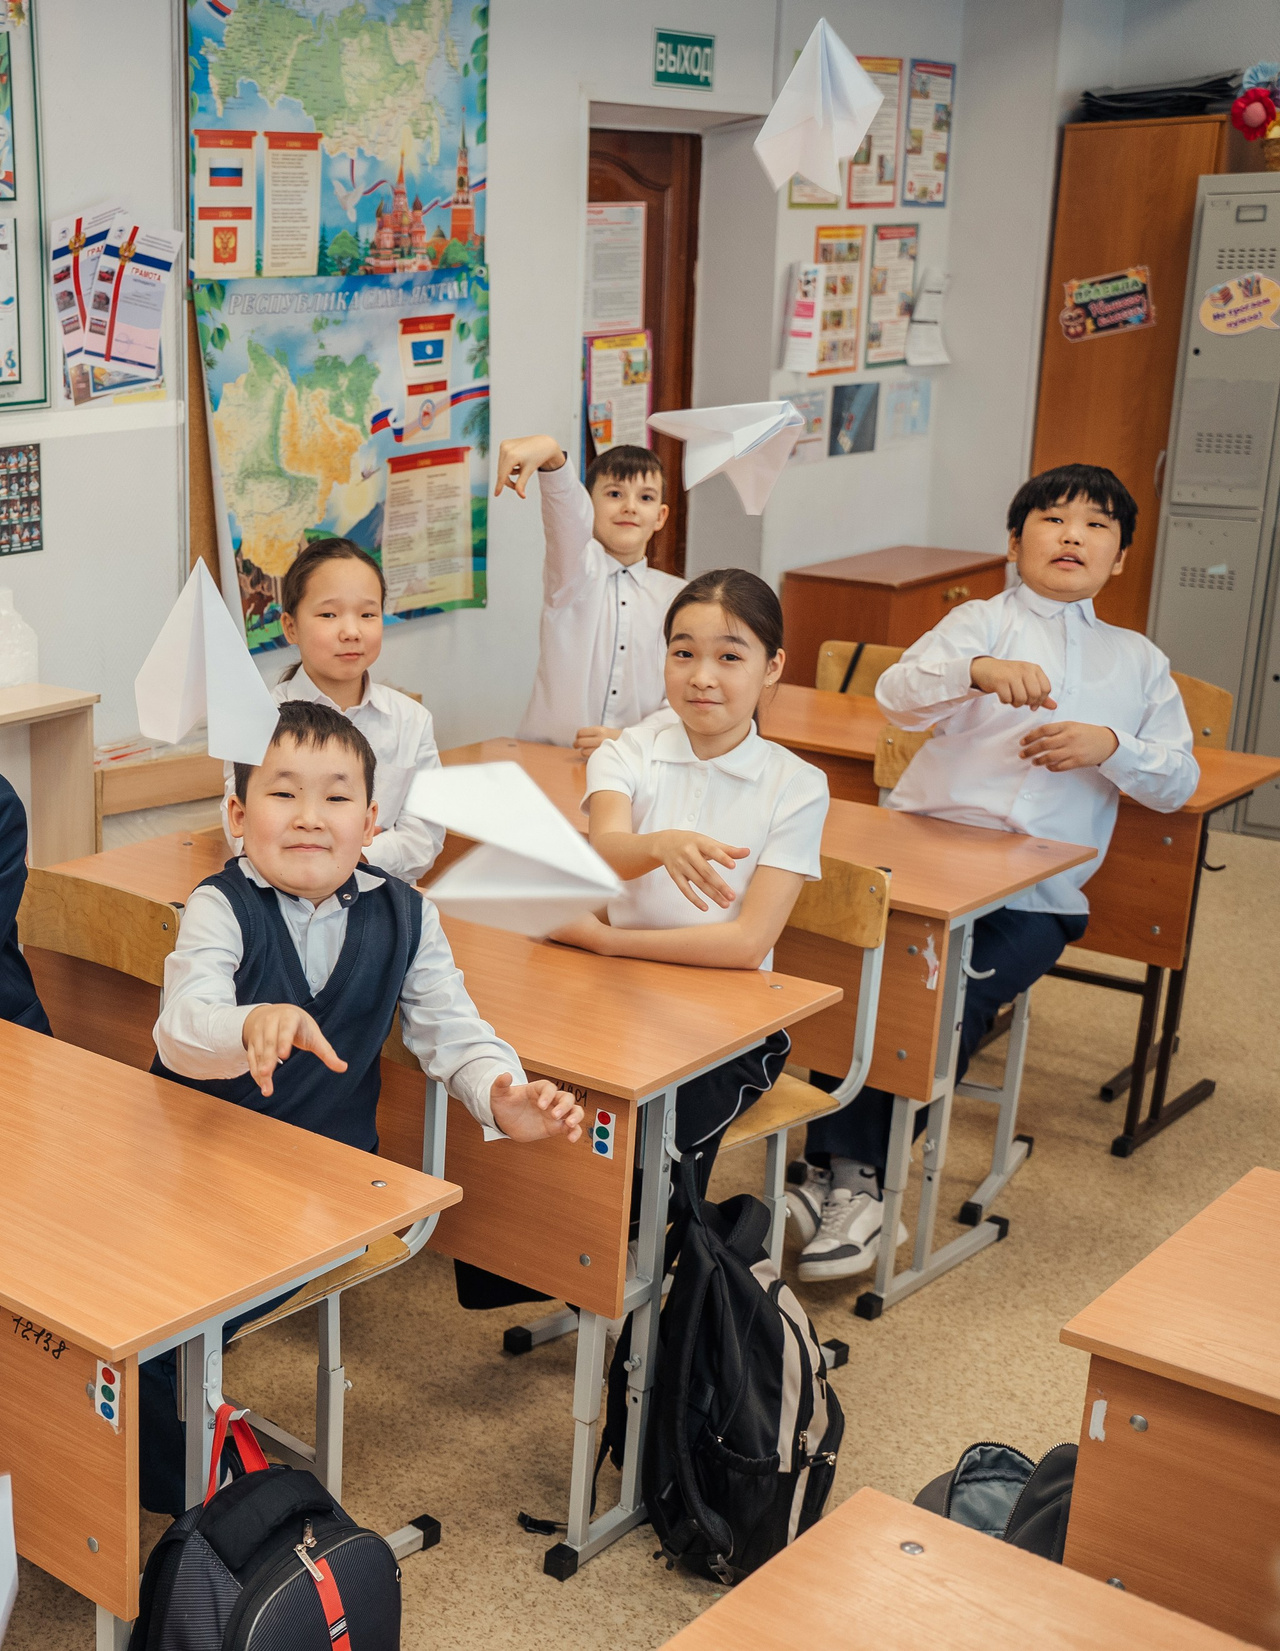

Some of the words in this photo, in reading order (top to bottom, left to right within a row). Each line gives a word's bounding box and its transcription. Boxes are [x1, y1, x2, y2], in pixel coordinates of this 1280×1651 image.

[656, 41, 714, 83] ВЫХОД
[131, 266, 162, 282] ГРАМОТА
[229, 292, 361, 315] РЕСПУБЛИКА
